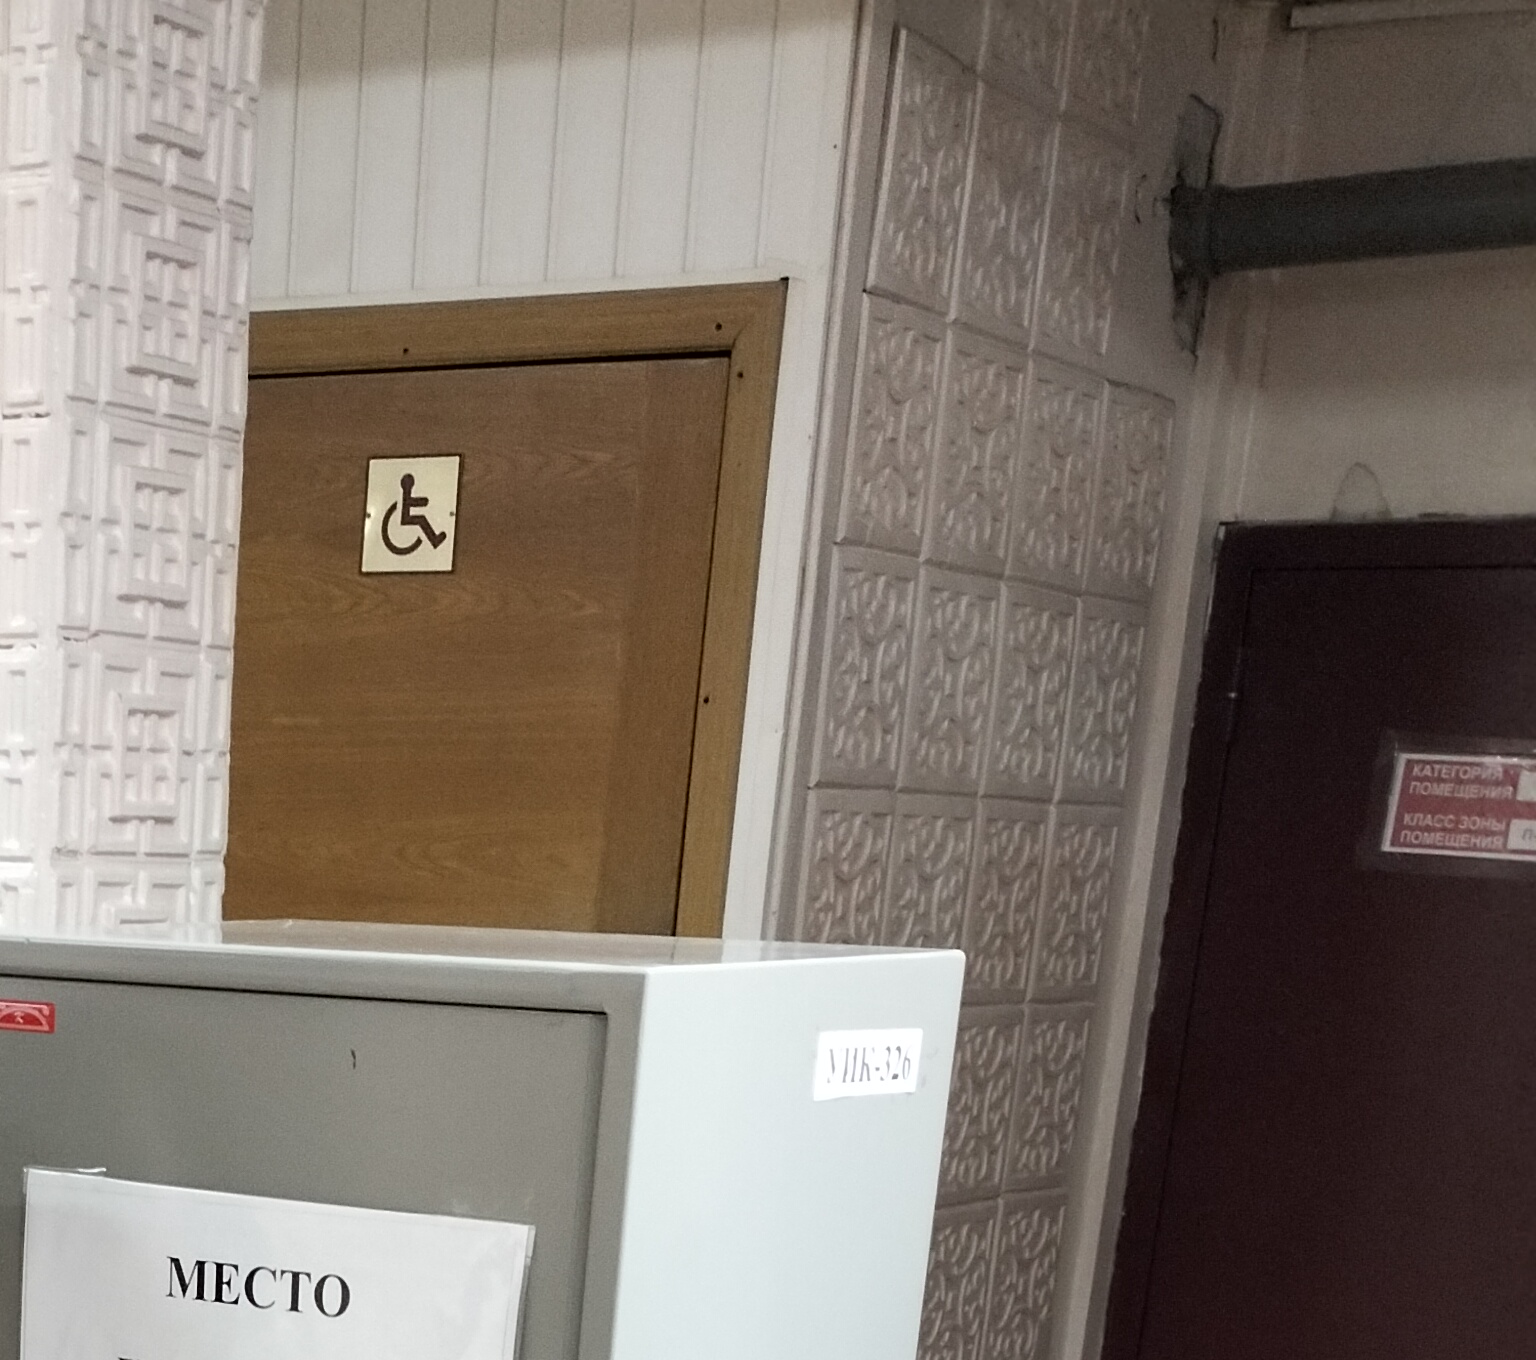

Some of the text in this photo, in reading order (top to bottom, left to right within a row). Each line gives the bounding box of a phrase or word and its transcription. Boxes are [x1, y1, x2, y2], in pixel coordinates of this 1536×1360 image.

[1413, 765, 1503, 780] КАТЕГОРИЯ
[1410, 782, 1514, 799] ПОМЕЩЕНИЯ
[1403, 812, 1506, 830] КЛАСС ЗОНЫ
[1400, 831, 1504, 849] ПОМЕЩЕНИЯ
[826, 1045, 912, 1084] УИК-326
[166, 1256, 351, 1319] МЕСТО
